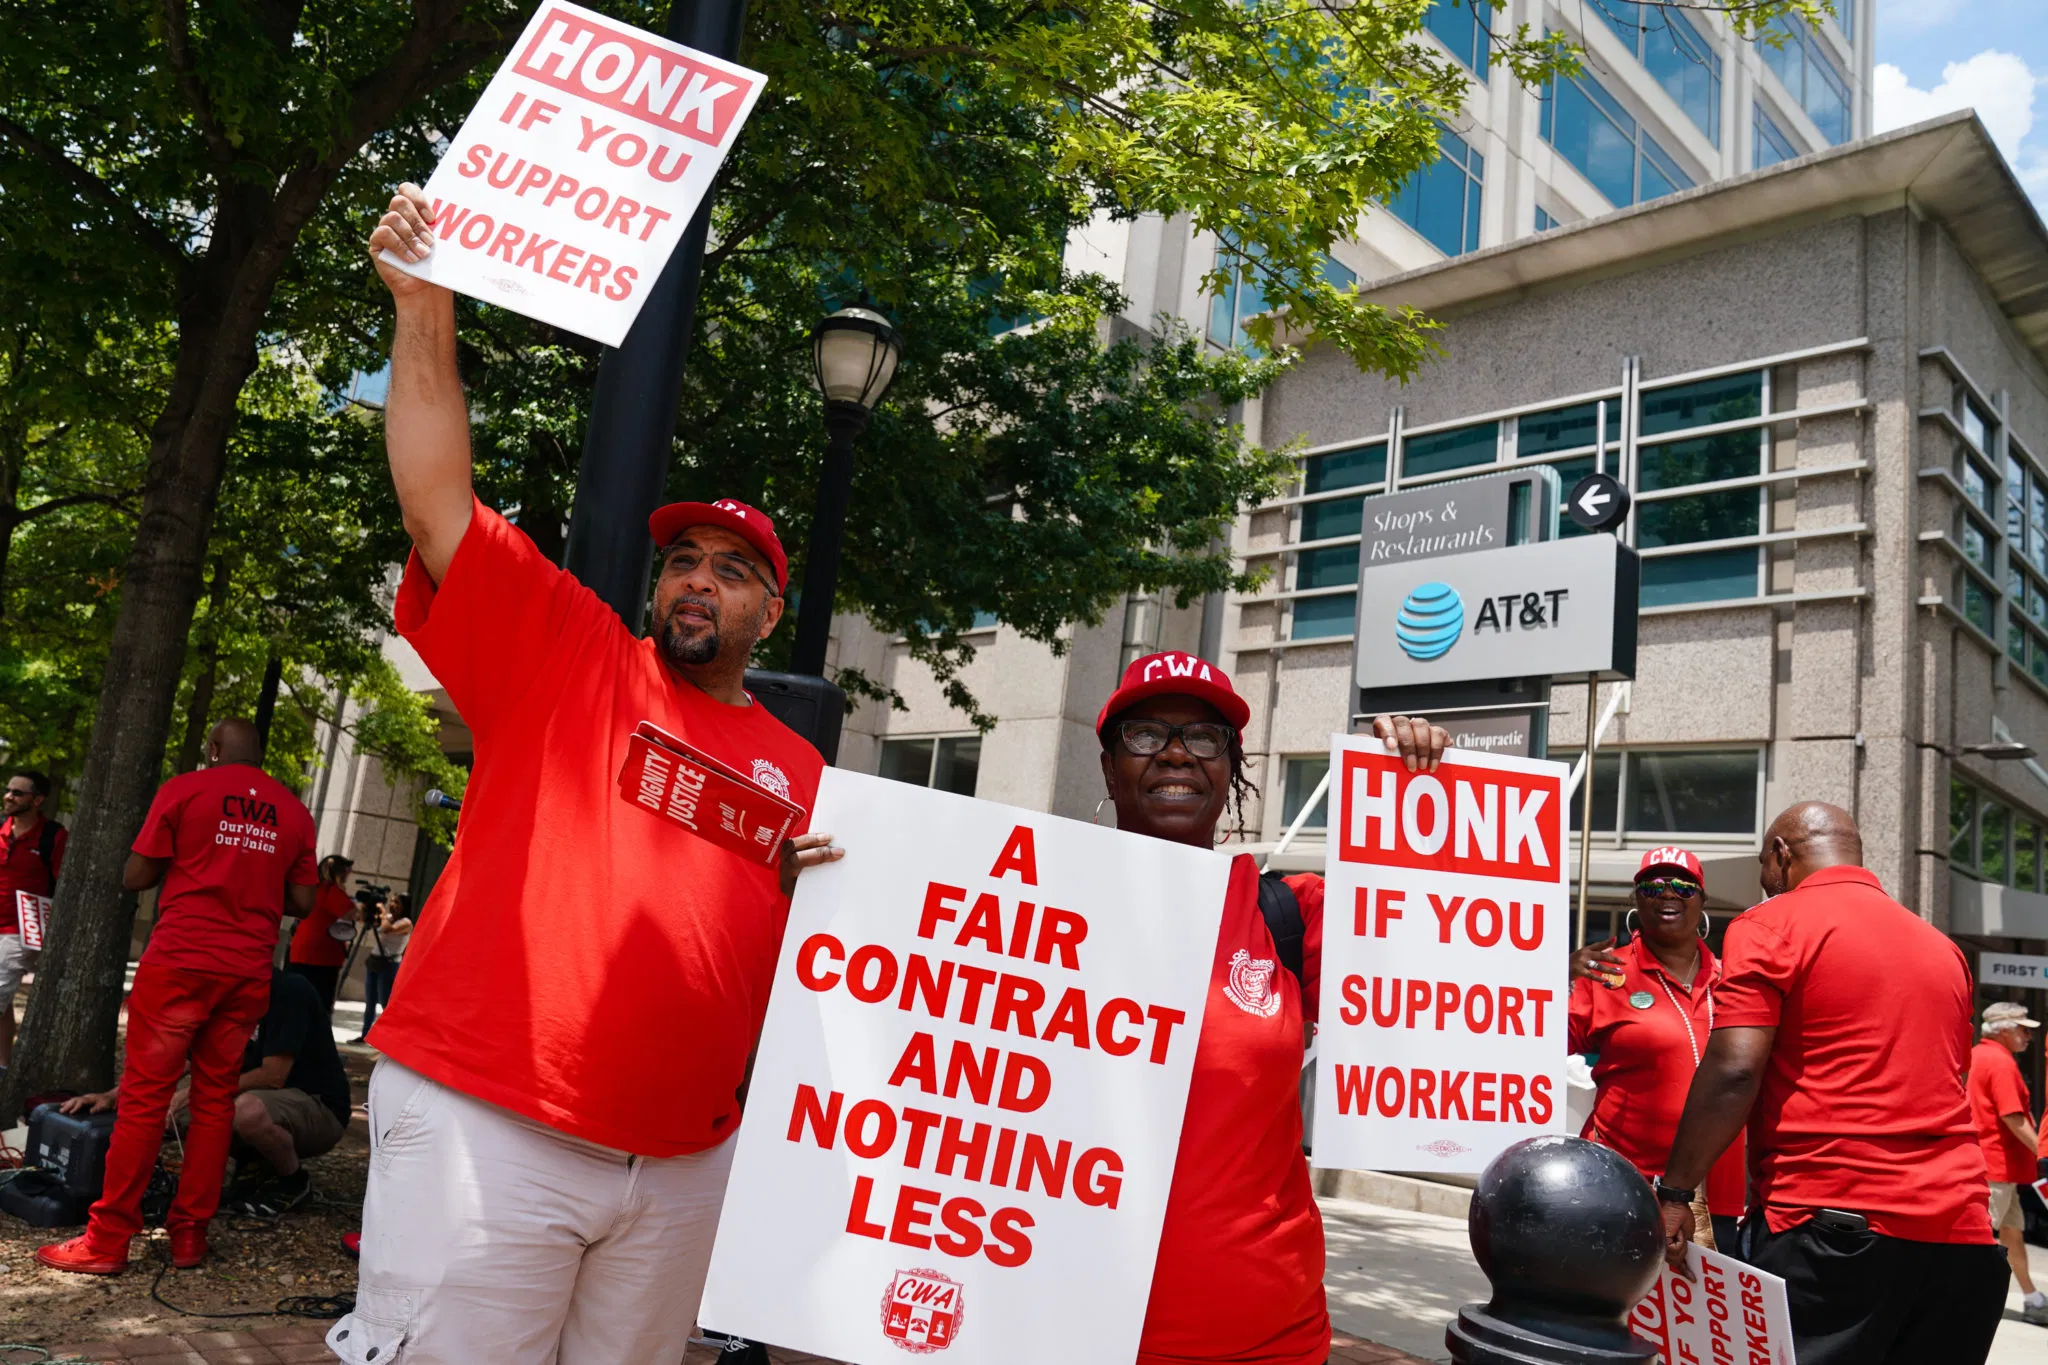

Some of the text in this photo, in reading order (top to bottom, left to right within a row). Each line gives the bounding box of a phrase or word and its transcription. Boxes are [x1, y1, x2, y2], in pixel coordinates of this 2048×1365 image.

[527, 19, 737, 134] HONK
[499, 92, 692, 183] IF YOU
[458, 143, 672, 242] SUPPORT
[430, 198, 638, 302] WORKERS
[1370, 524, 1494, 560] Restaurants
[1372, 500, 1458, 534] Shops &
[1474, 588, 1568, 632] AT&T
[1144, 655, 1212, 682] CWA
[750, 758, 773, 770] LOCAL
[1456, 730, 1523, 751] Chiropractic
[637, 748, 672, 810] DIGNITY
[666, 763, 706, 831] JUSTICE
[219, 820, 277, 841] Our Voice
[222, 795, 278, 826] CWA
[718, 802, 742, 838] for all
[754, 825, 775, 846] CWA
[1350, 766, 1551, 869] HONK
[215, 834, 275, 854] Our Union
[989, 825, 1038, 886] A
[1650, 847, 1689, 868] CWA
[22, 894, 42, 947] HONK
[917, 881, 1089, 971] FAIR
[1353, 886, 1544, 952] IF YOU
[796, 933, 1186, 1065] CONTRACT
[1993, 963, 2038, 977] FIRST
[1339, 974, 1553, 1038] SUPPORT
[888, 1031, 1052, 1114] AND
[1335, 1063, 1553, 1125] WORKERS
[786, 1083, 1124, 1210] NOTHING
[845, 1176, 1036, 1267] LESS
[897, 1278, 955, 1309] CWA
[1669, 1264, 1695, 1325] YO
